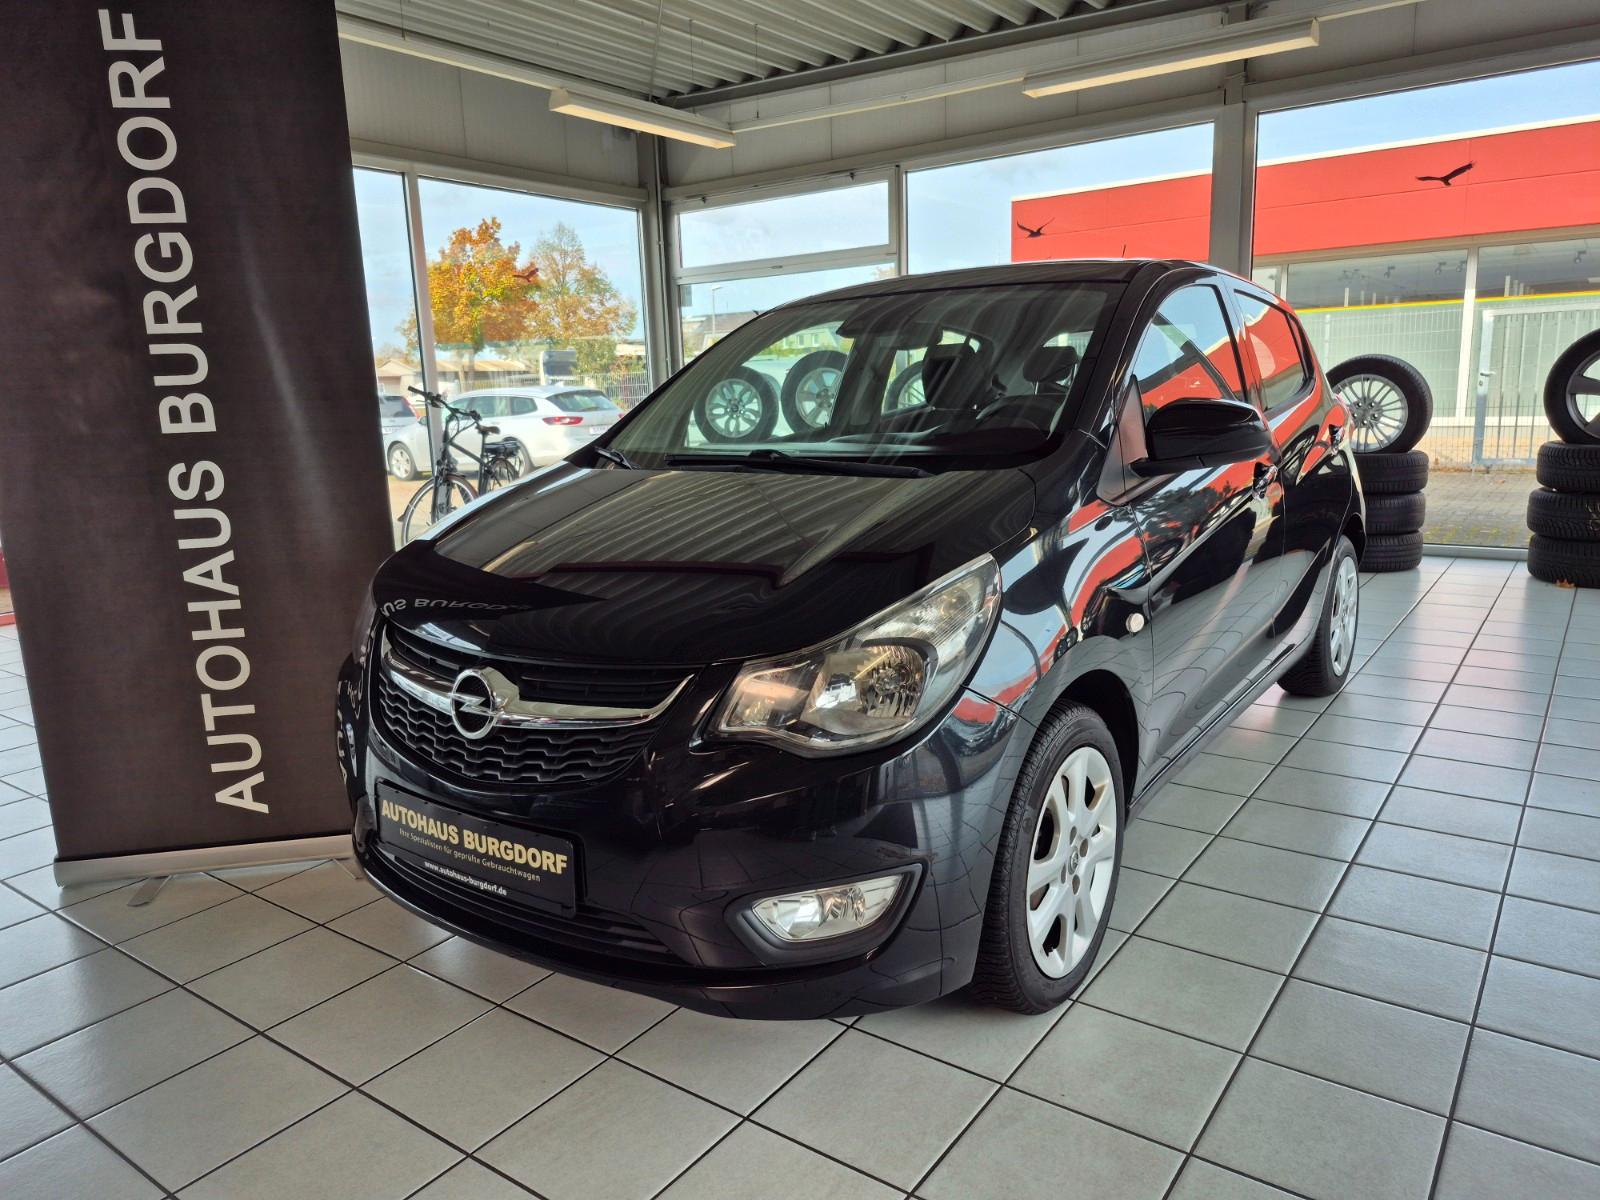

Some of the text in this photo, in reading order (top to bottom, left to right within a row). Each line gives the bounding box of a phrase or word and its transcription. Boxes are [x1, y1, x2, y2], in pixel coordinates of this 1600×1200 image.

[98, 9, 270, 814] AUTOHAUS BURGDORF
[381, 799, 568, 875] AUTOHAUS BURGDORF
[443, 843, 453, 855] für
[481, 858, 541, 882] Gebrauchtwagen
[424, 861, 507, 896] www.autohaus-burgdorf.de
